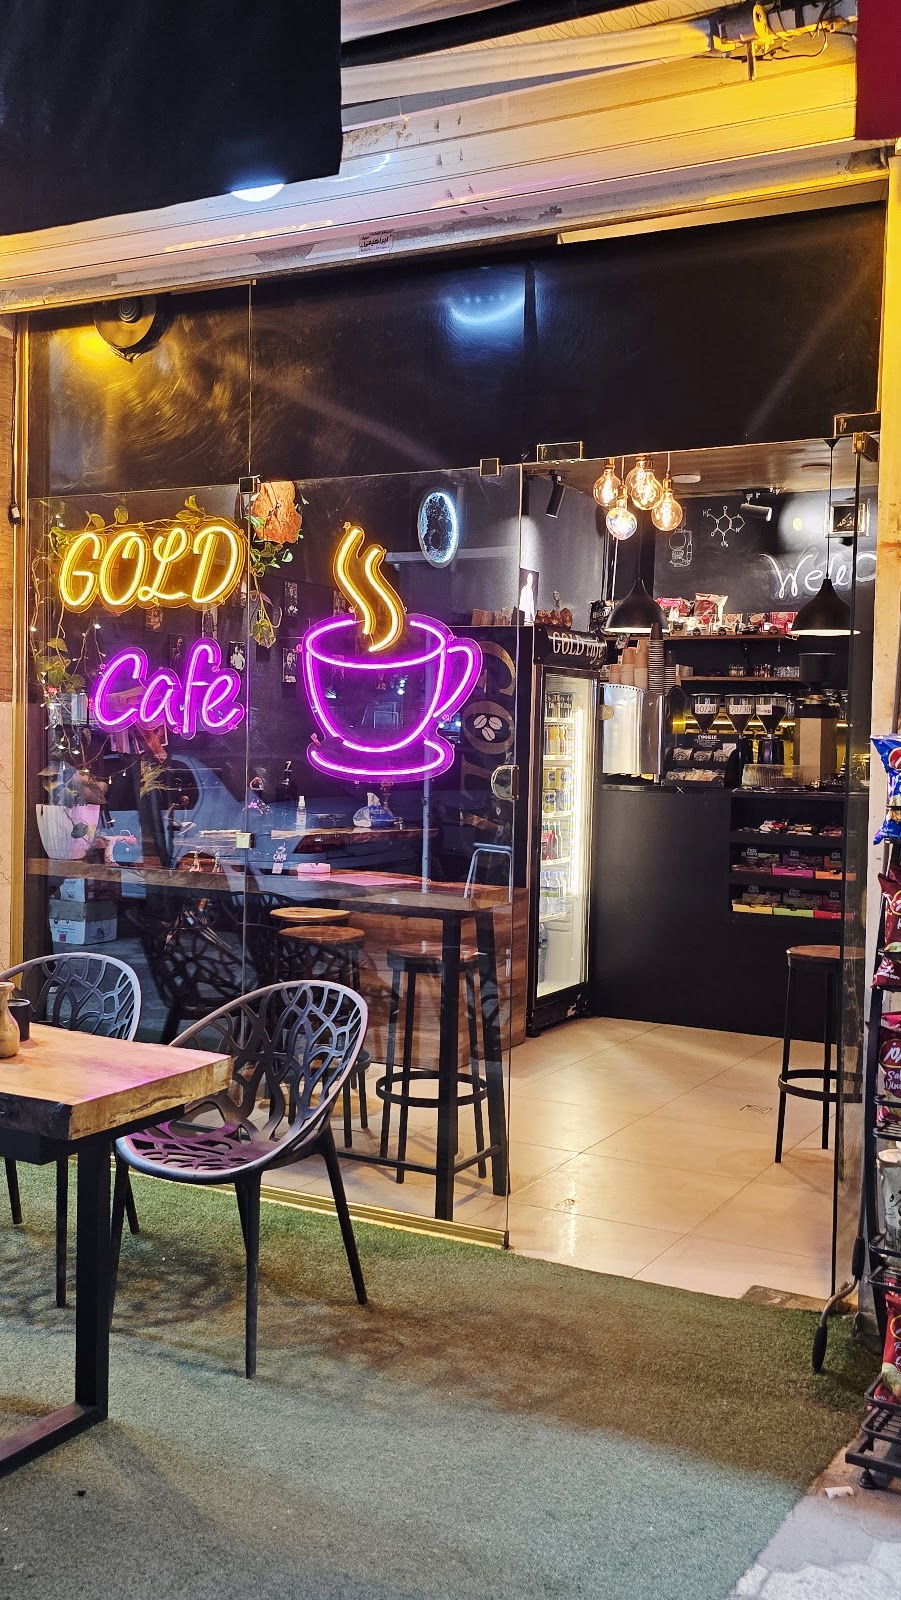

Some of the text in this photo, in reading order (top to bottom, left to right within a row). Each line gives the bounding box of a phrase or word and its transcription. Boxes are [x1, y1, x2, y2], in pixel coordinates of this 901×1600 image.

[60, 525, 242, 606] GOLD
[552, 631, 585, 656] GOLD
[93, 643, 242, 734] Cafe
